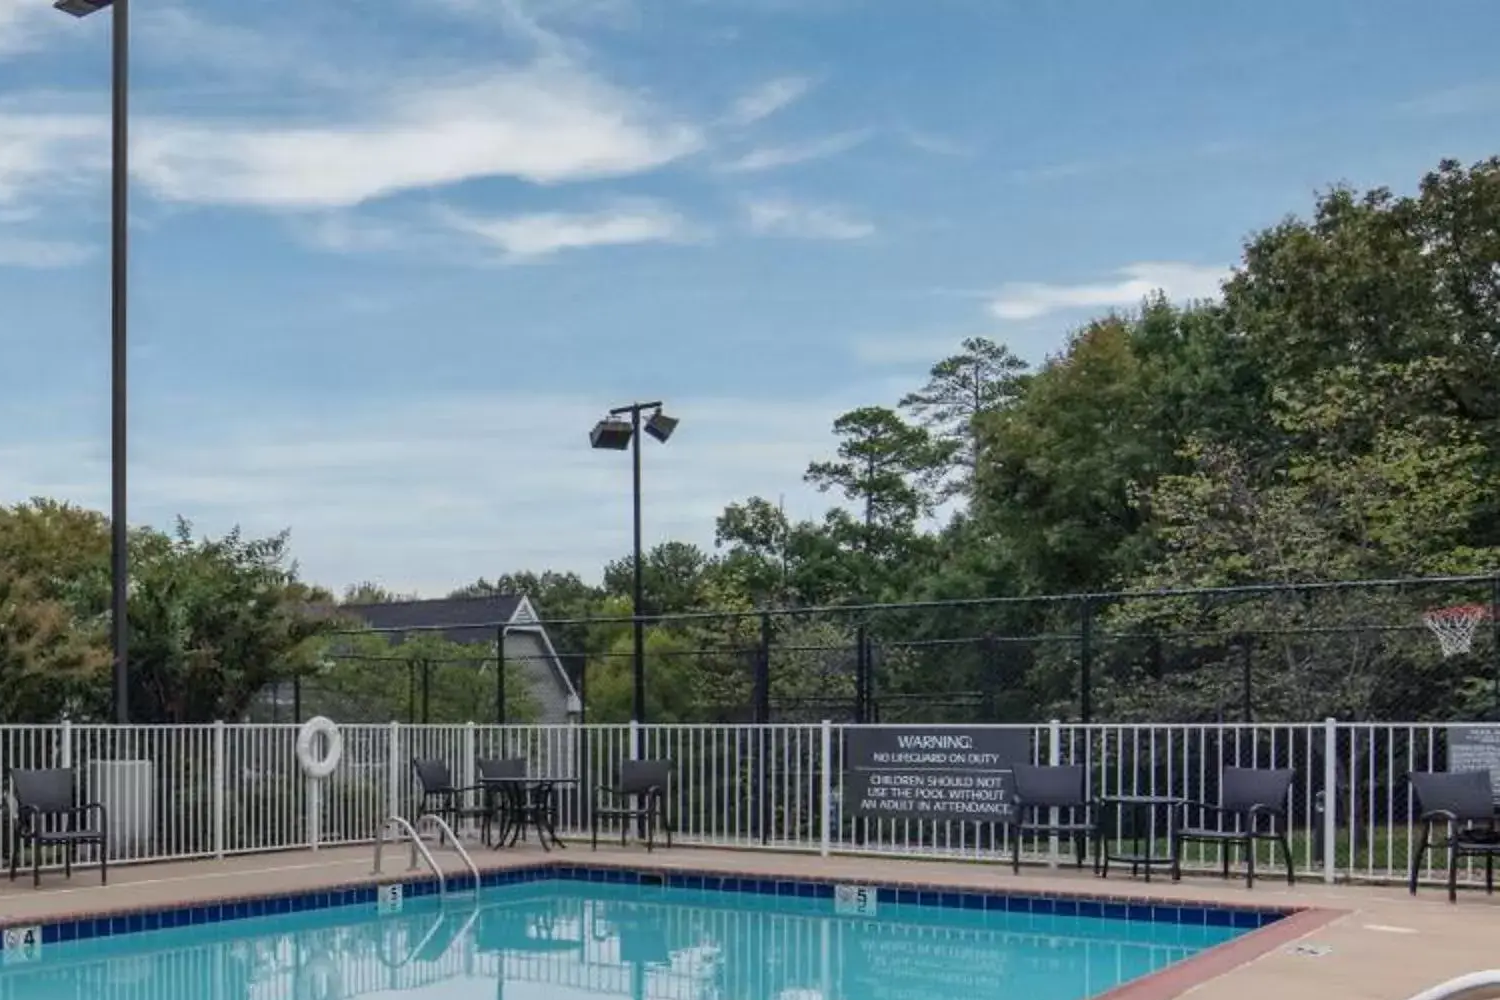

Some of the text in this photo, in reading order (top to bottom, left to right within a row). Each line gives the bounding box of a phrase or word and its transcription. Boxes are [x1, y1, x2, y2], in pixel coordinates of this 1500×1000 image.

[873, 752, 1000, 765] NO LIFEGUARD ON DUTY
[870, 775, 1002, 788] CHILDREN SHOULD NOT
[867, 787, 1004, 801] USE THE POOL WITHOUT
[861, 799, 877, 809] AN
[879, 799, 915, 811] ADULT
[918, 800, 931, 811] IN
[23, 930, 35, 945] 4
